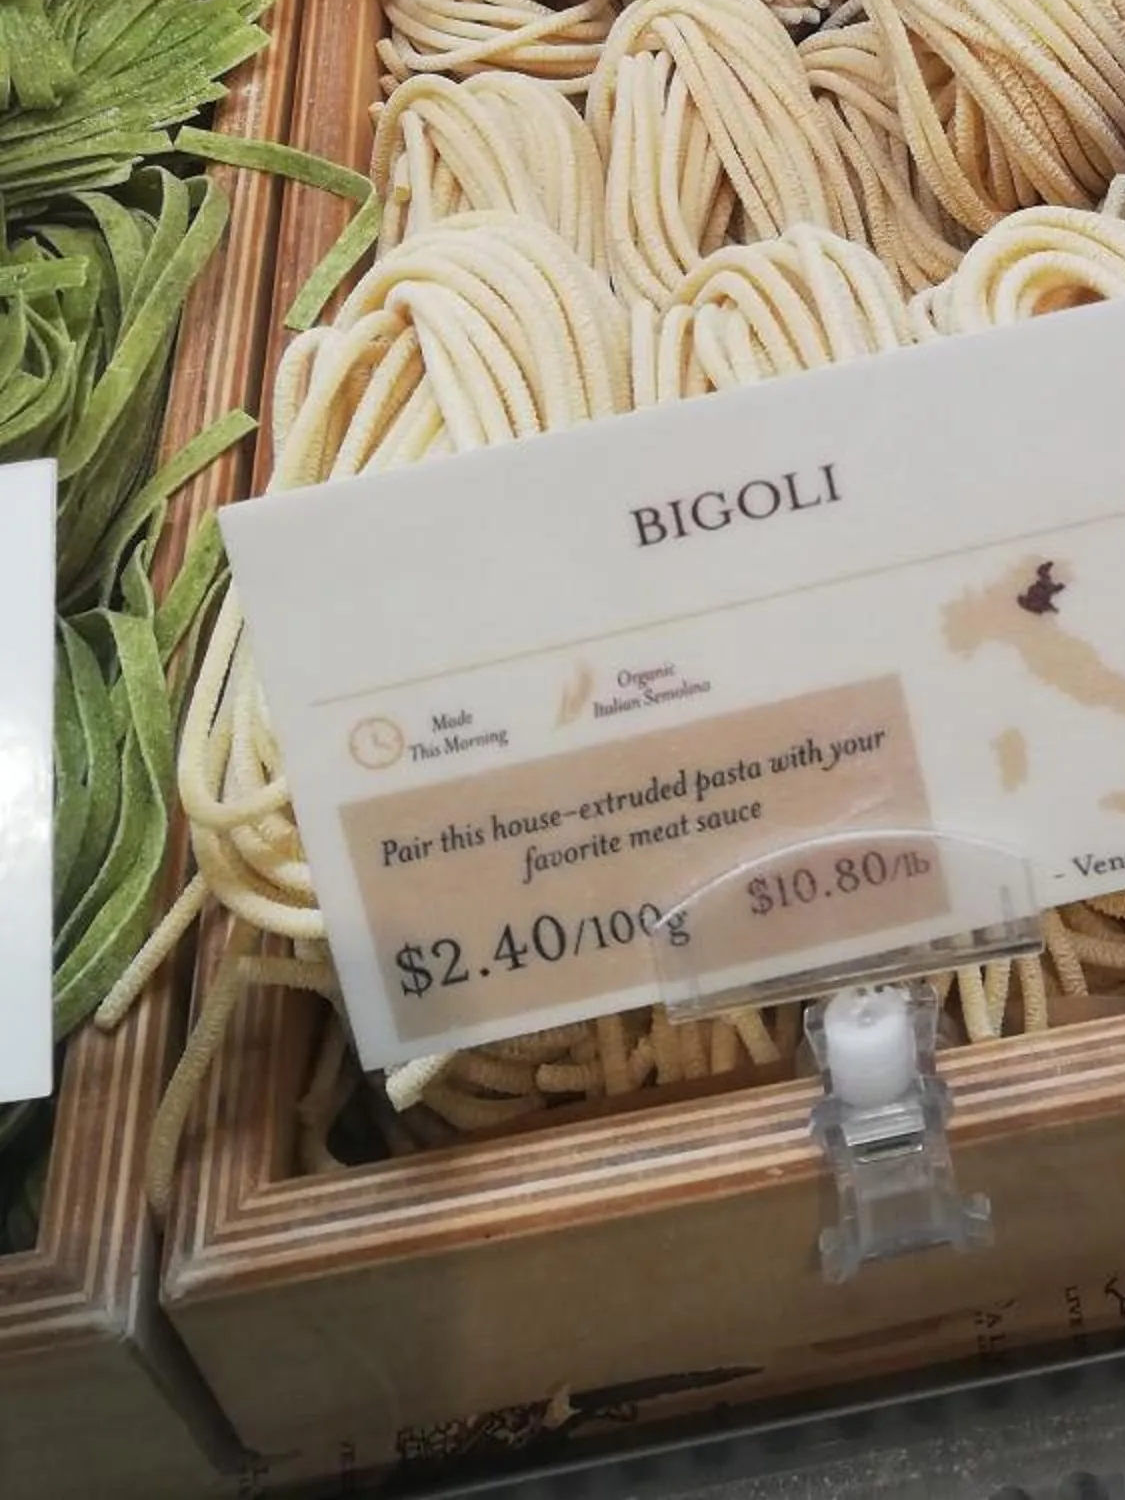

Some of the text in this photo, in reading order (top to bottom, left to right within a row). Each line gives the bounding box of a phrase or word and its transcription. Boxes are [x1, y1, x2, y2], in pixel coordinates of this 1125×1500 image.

[628, 462, 843, 548] BIGOLI
[592, 678, 712, 720] Italian Semolina
[616, 661, 676, 690] Organic
[408, 728, 510, 763] This Morning
[431, 708, 474, 734] Made
[380, 836, 433, 868] Pair
[440, 824, 485, 853] this
[694, 759, 763, 802] pasta
[768, 737, 824, 776] with
[820, 728, 887, 772] your
[521, 800, 763, 885] favorite meat sauce
[746, 850, 932, 916] $10.80/lb
[395, 902, 691, 998] $2.40/100g
